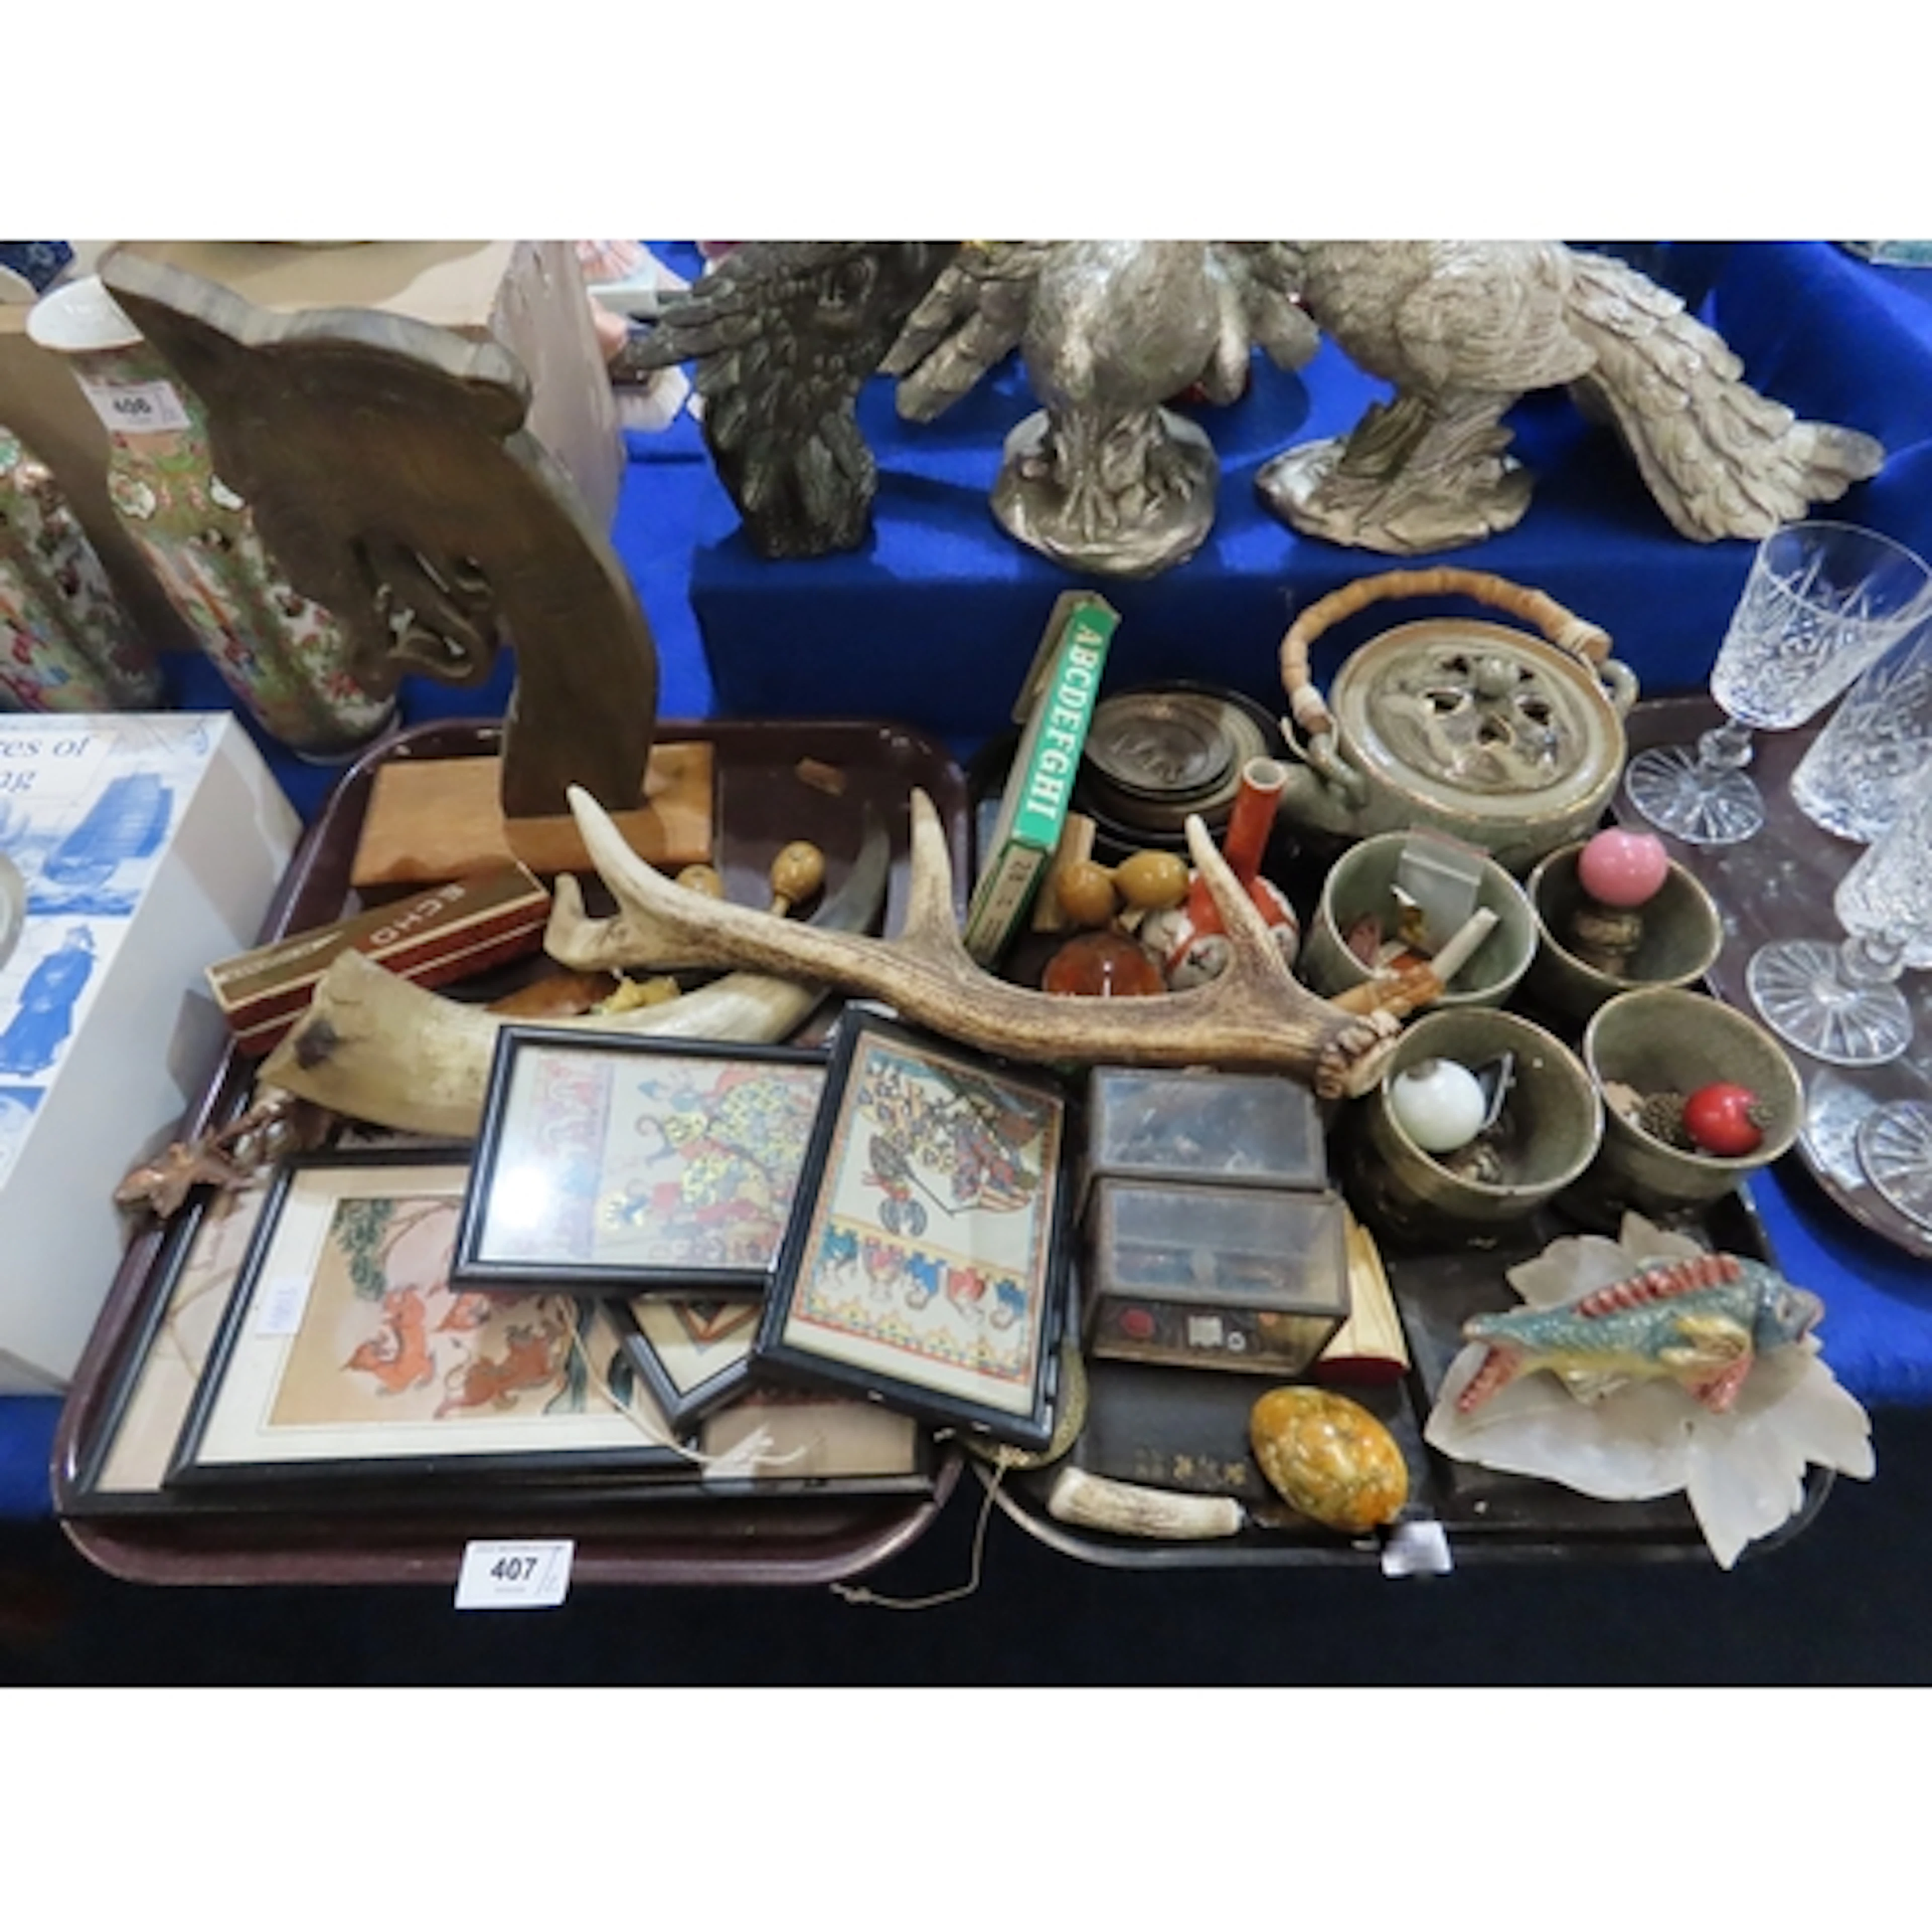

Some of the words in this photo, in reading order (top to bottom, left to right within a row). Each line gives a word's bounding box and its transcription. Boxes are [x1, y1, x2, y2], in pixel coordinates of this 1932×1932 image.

[1026, 623, 1104, 820] ABCDEFGHI
[52, 736, 90, 758] of
[490, 1557, 538, 1580] 407
